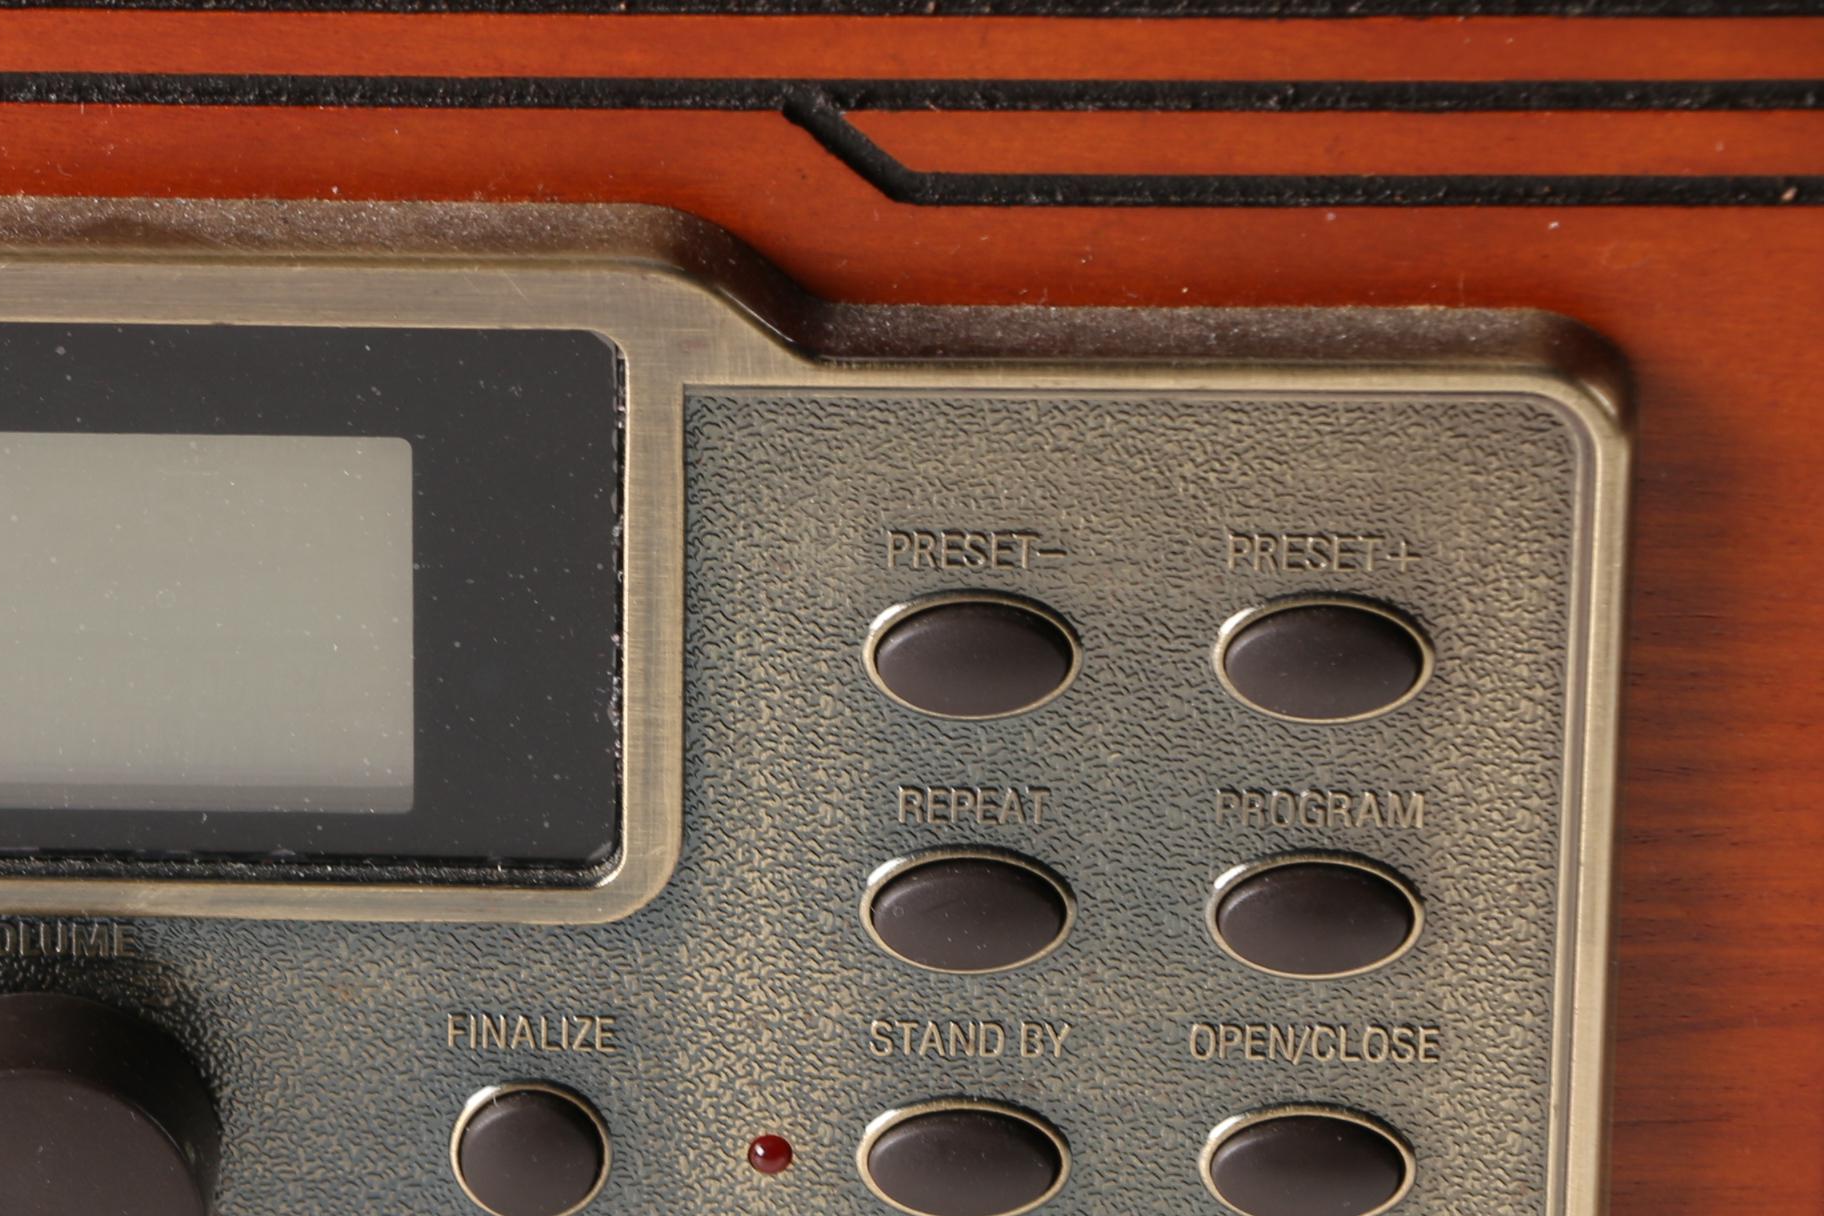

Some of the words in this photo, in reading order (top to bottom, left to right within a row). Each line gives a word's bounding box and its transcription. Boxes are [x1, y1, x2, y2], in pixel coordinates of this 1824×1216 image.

[1227, 534, 1420, 572] PRESET+
[898, 786, 1051, 825] REPEAT
[1216, 790, 1425, 829] PROGRAM
[447, 1012, 618, 1052] FINALIZE
[869, 1020, 1006, 1058] STAND
[1021, 1022, 1071, 1059] BY
[1189, 1023, 1441, 1063] OPEN/CLOSE
